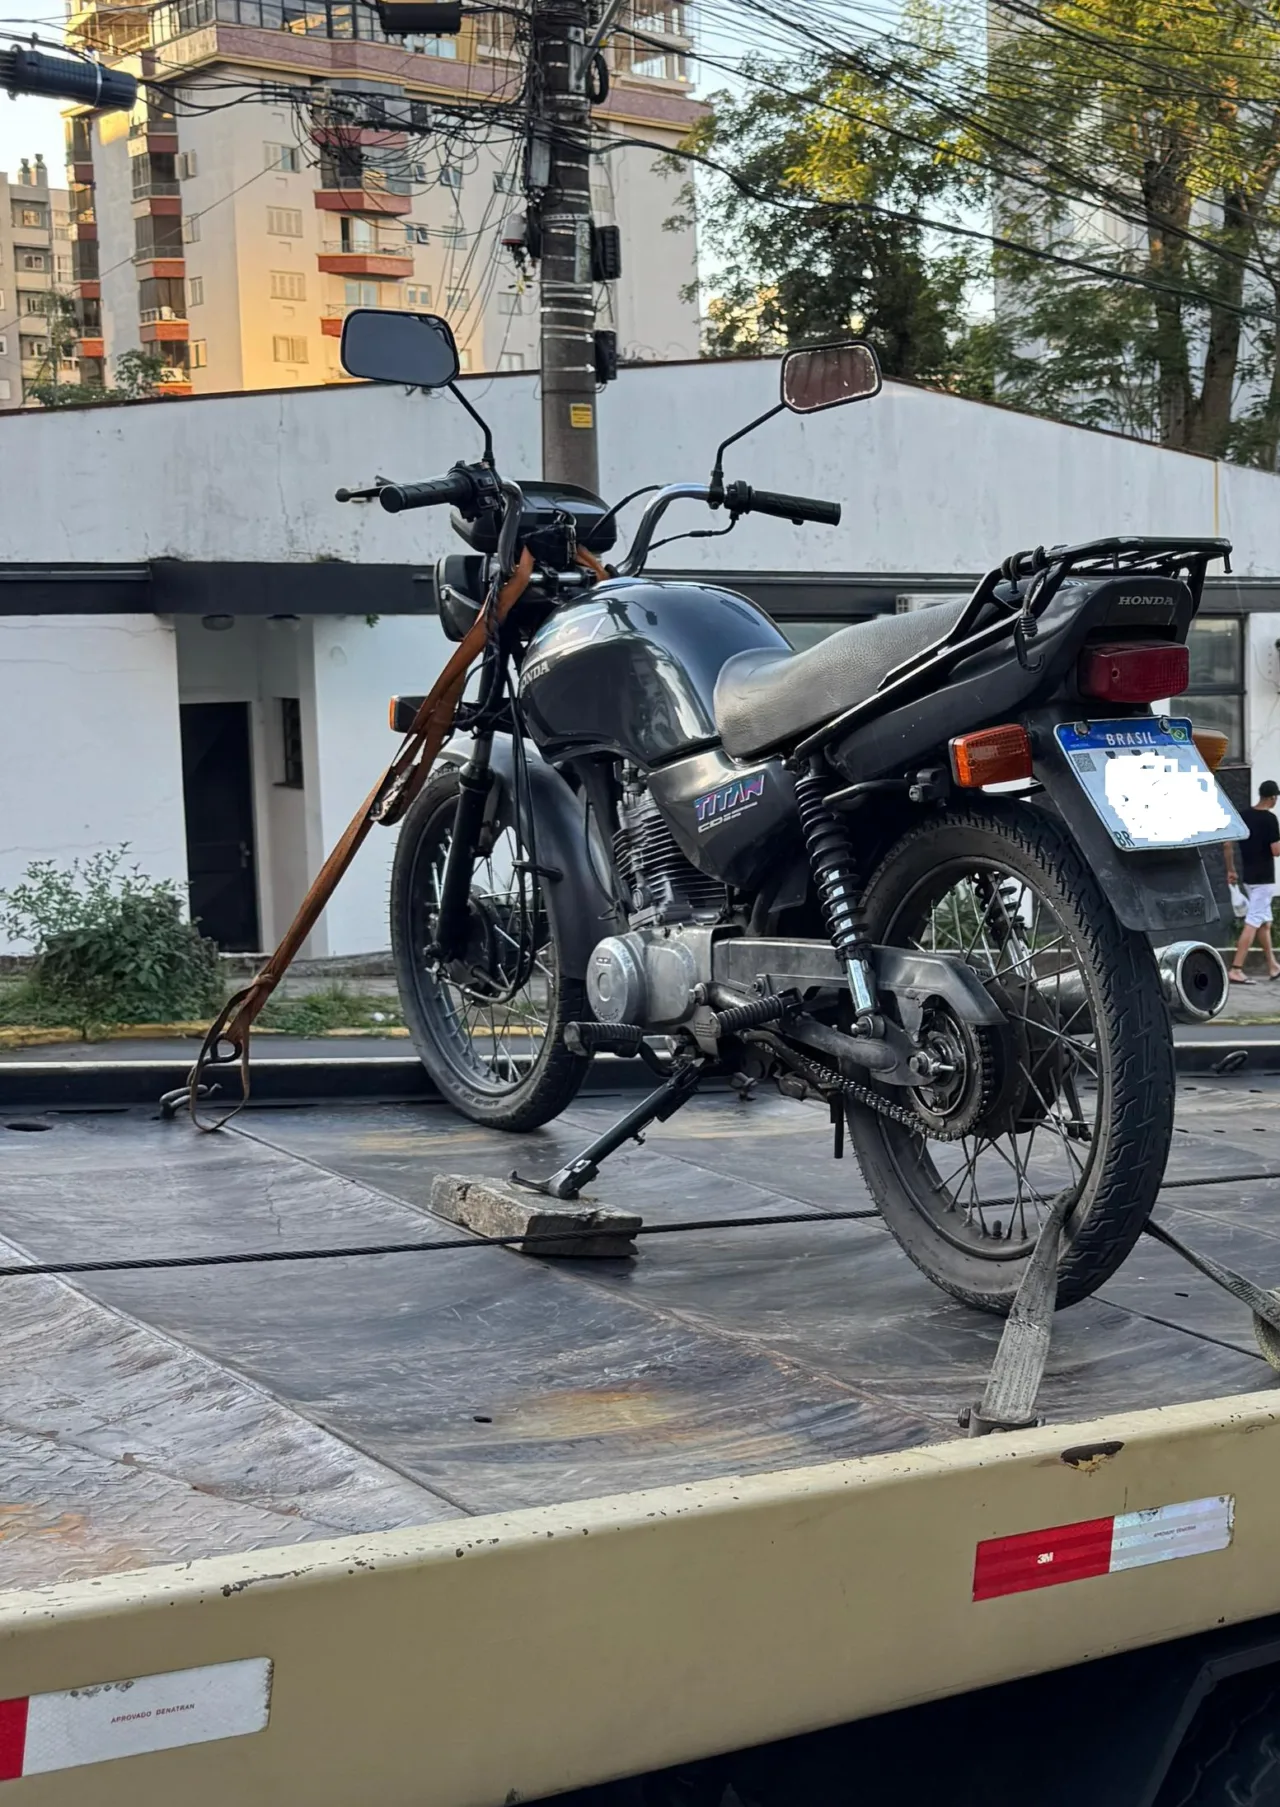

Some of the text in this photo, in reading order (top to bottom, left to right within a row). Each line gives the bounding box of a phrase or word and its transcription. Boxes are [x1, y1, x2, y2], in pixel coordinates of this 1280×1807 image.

[1118, 595, 1175, 606] HONDA
[1105, 731, 1157, 746] BRASIL
[694, 774, 765, 821] TITAN
[1112, 830, 1135, 848] BR
[1037, 1552, 1054, 1564] 3M
[110, 1703, 195, 1724] APROVADO DENATRAN
